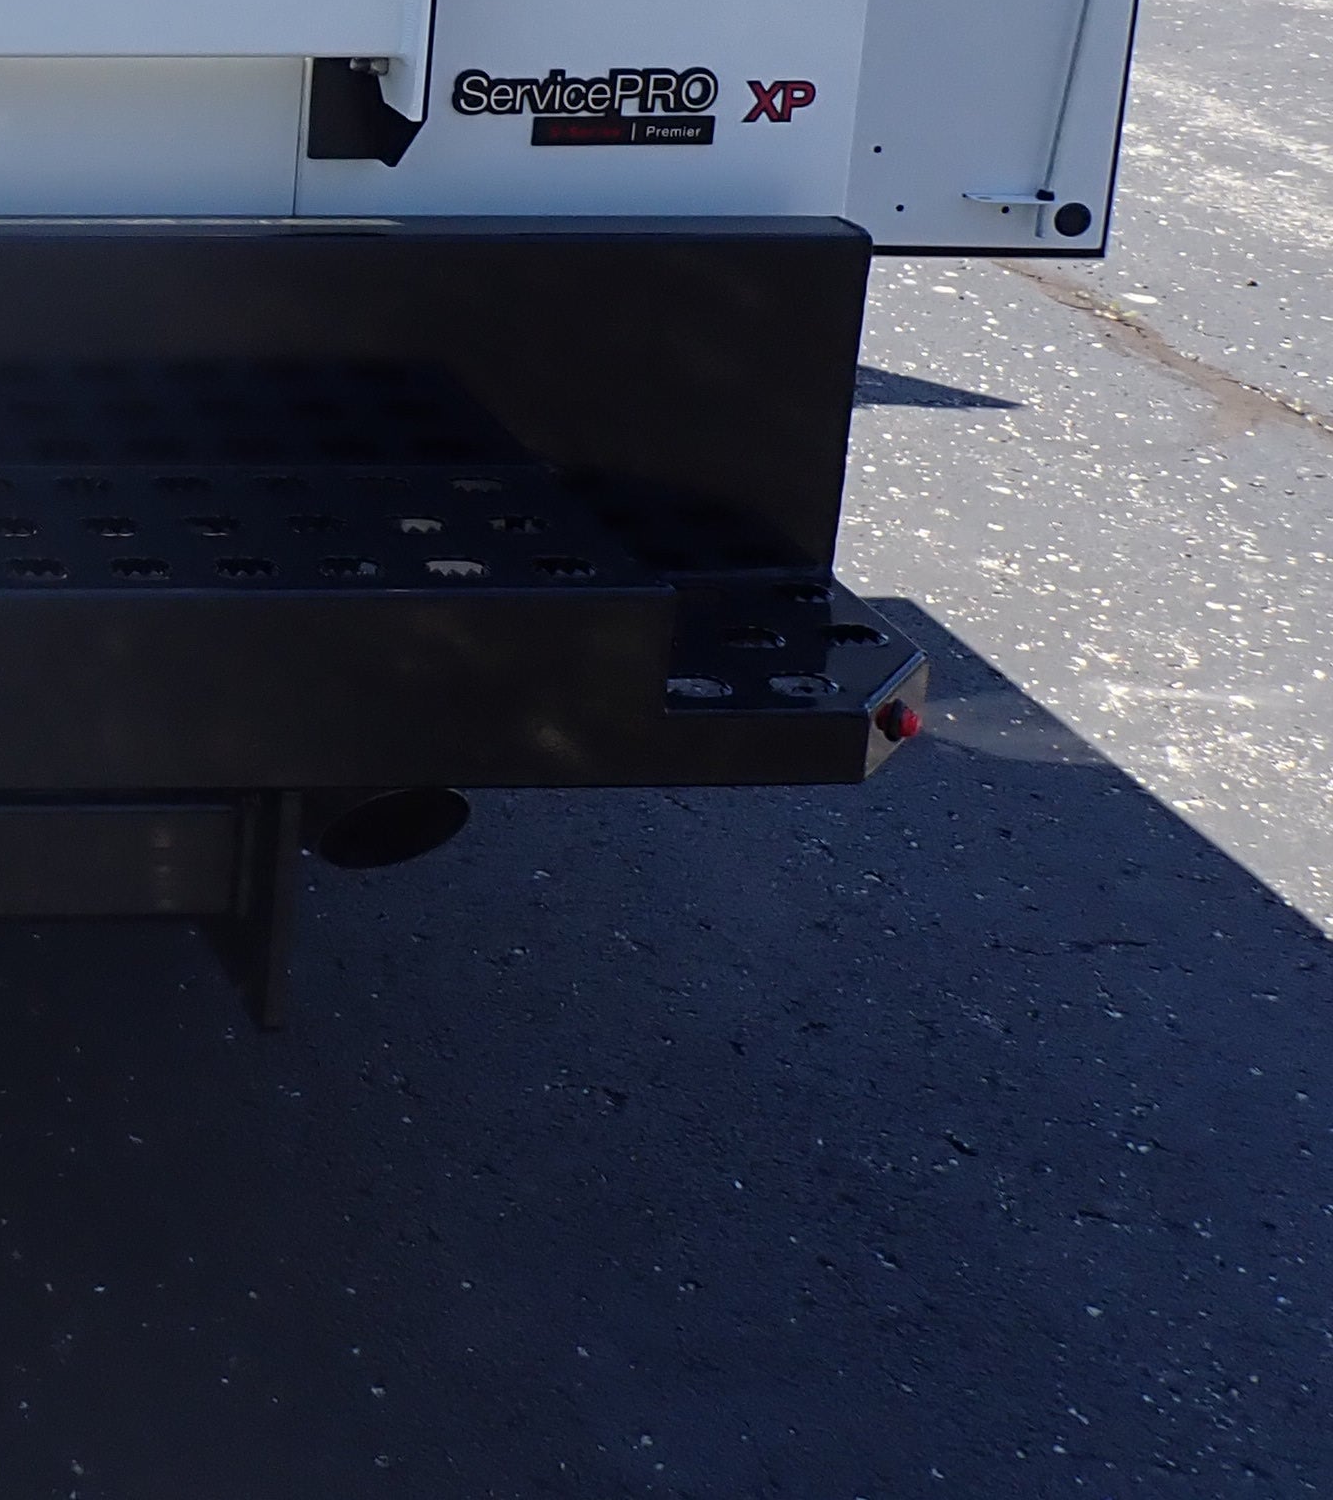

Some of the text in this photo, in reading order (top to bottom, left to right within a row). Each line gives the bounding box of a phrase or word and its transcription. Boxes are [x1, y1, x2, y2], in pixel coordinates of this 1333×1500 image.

[455, 70, 817, 124] ServicePRO XP
[645, 124, 703, 140] Premier
